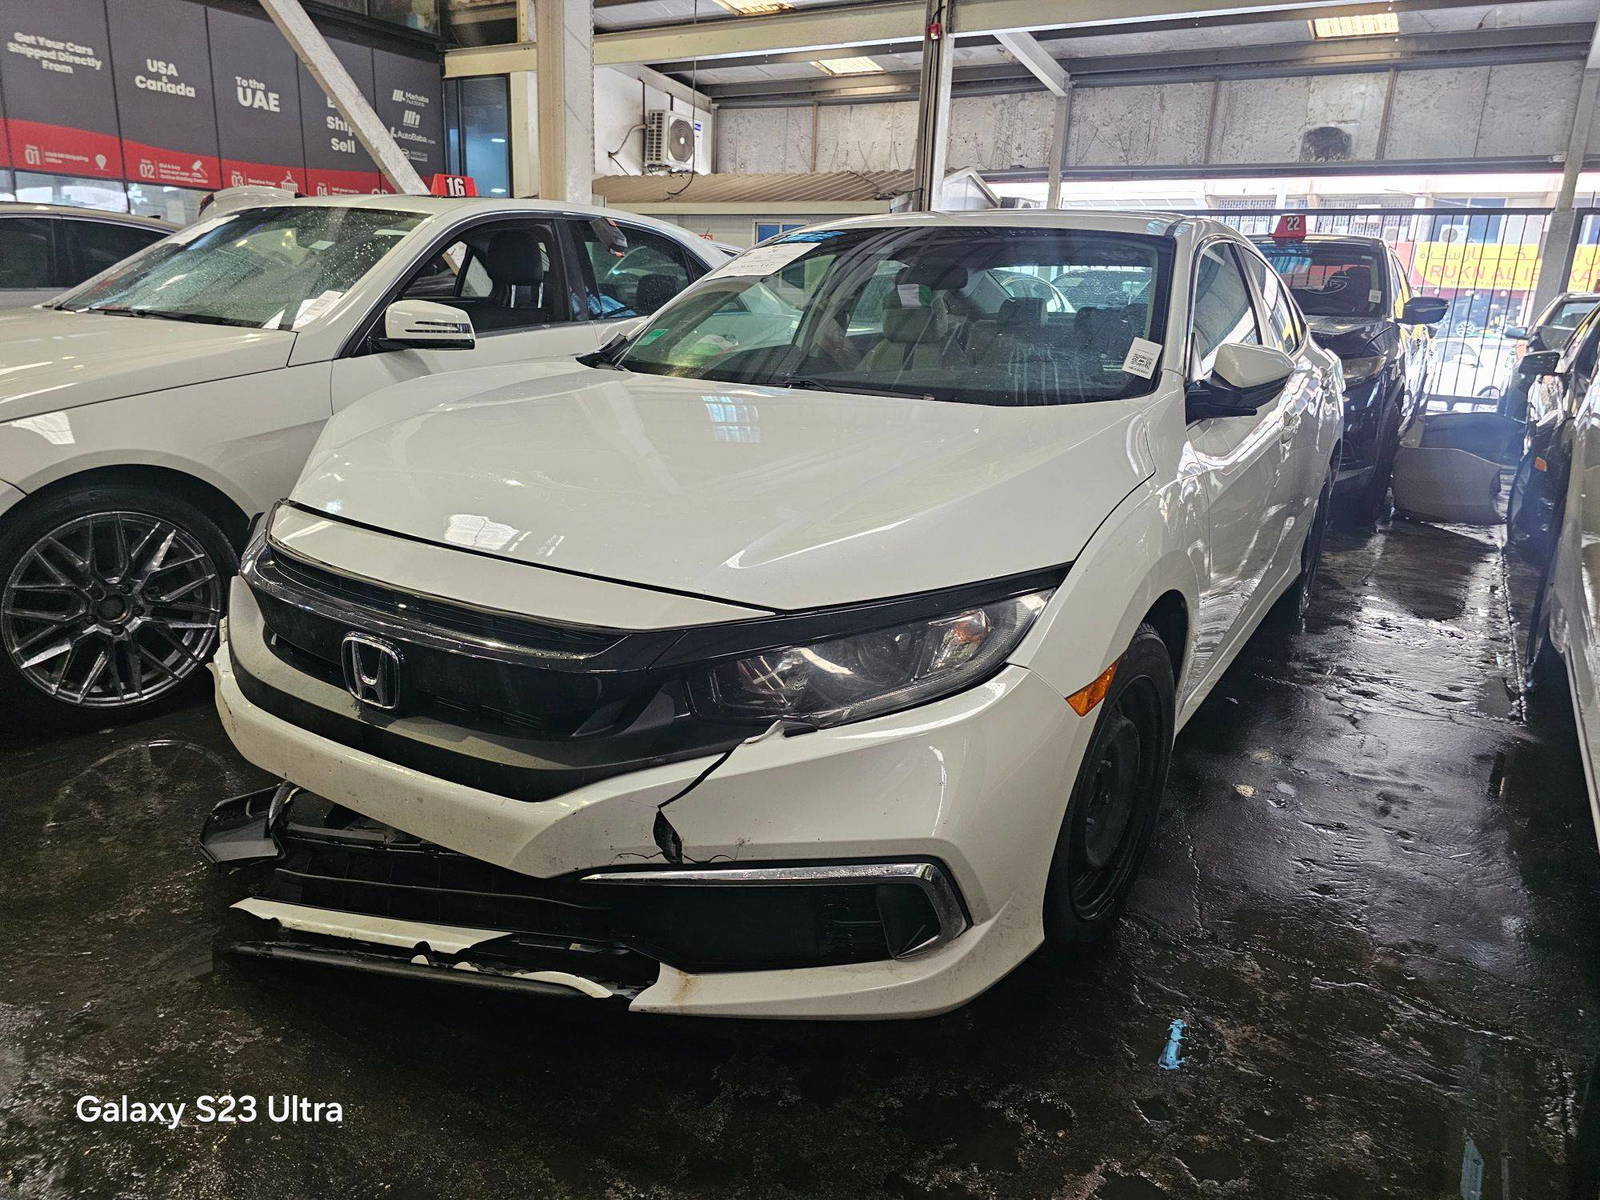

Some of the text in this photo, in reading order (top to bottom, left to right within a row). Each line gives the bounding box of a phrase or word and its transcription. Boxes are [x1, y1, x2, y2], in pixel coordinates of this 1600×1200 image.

[14, 32, 94, 55] Get Your Cars
[7, 42, 102, 70] Shipped Directly
[42, 60, 74, 74] From
[146, 58, 179, 77] USA
[134, 75, 196, 98] Canada
[235, 76, 266, 90] To the
[236, 86, 281, 112] UAE
[331, 137, 356, 154] Sell
[139, 163, 155, 179] 02
[446, 176, 466, 197] 16
[1287, 216, 1301, 231] 22
[1429, 264, 1486, 280] RUKN
